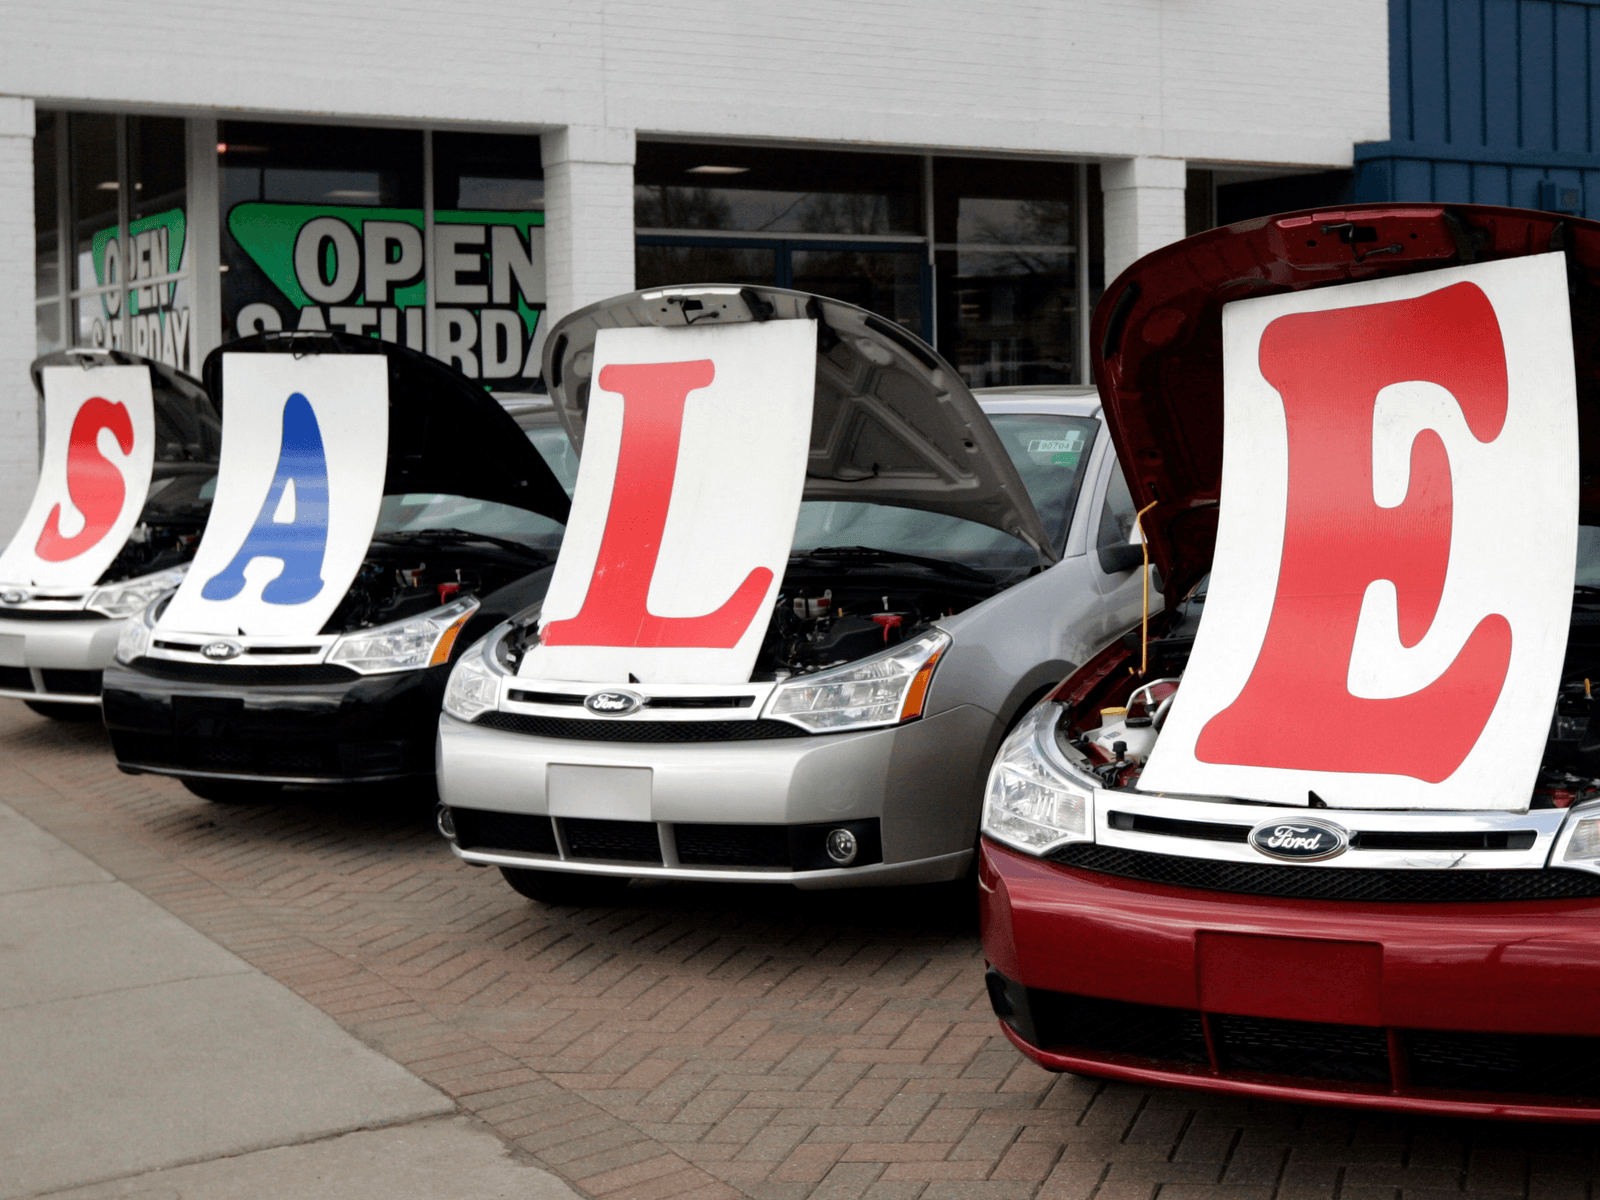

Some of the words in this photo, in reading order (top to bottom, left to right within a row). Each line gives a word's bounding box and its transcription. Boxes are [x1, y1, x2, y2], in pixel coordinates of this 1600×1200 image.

[294, 215, 546, 304] OPEN
[593, 693, 626, 710] Ford
[1267, 825, 1322, 851] Ford
